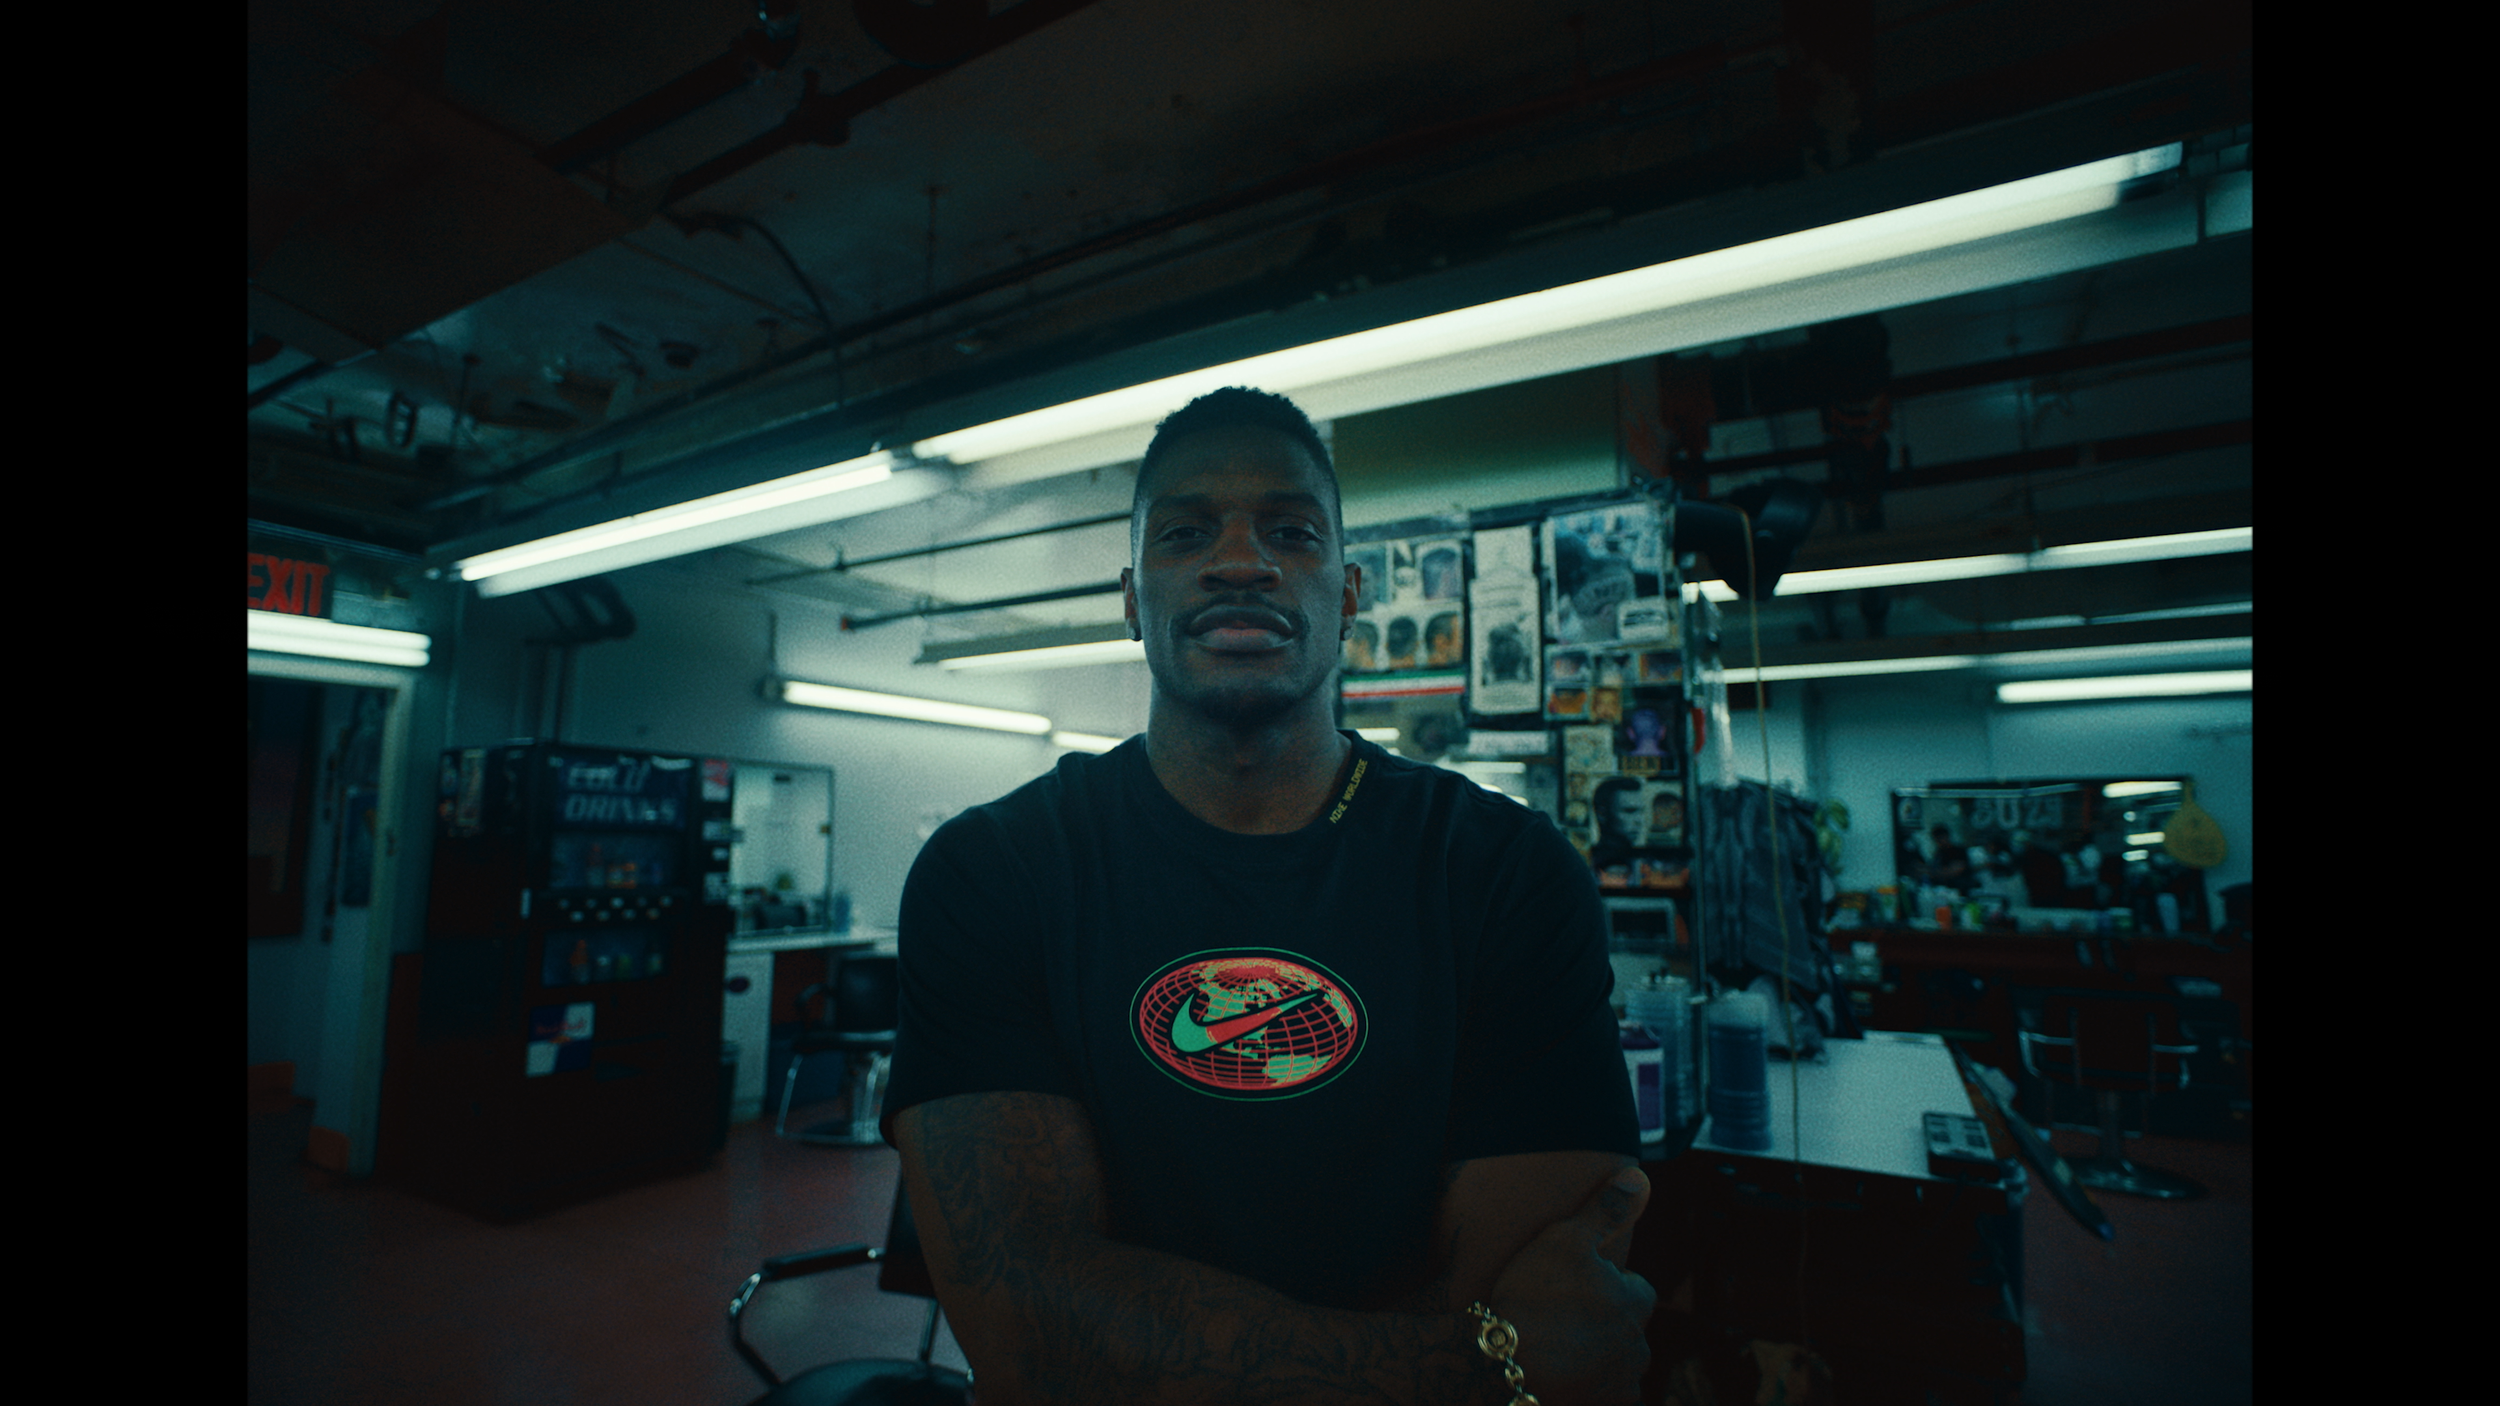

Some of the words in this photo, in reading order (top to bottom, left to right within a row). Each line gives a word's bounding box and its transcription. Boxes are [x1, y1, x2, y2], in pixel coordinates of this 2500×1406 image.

[247, 552, 331, 616] EXIT
[1329, 801, 1348, 824] NIKE
[1342, 757, 1368, 801] WORLDWIDE
